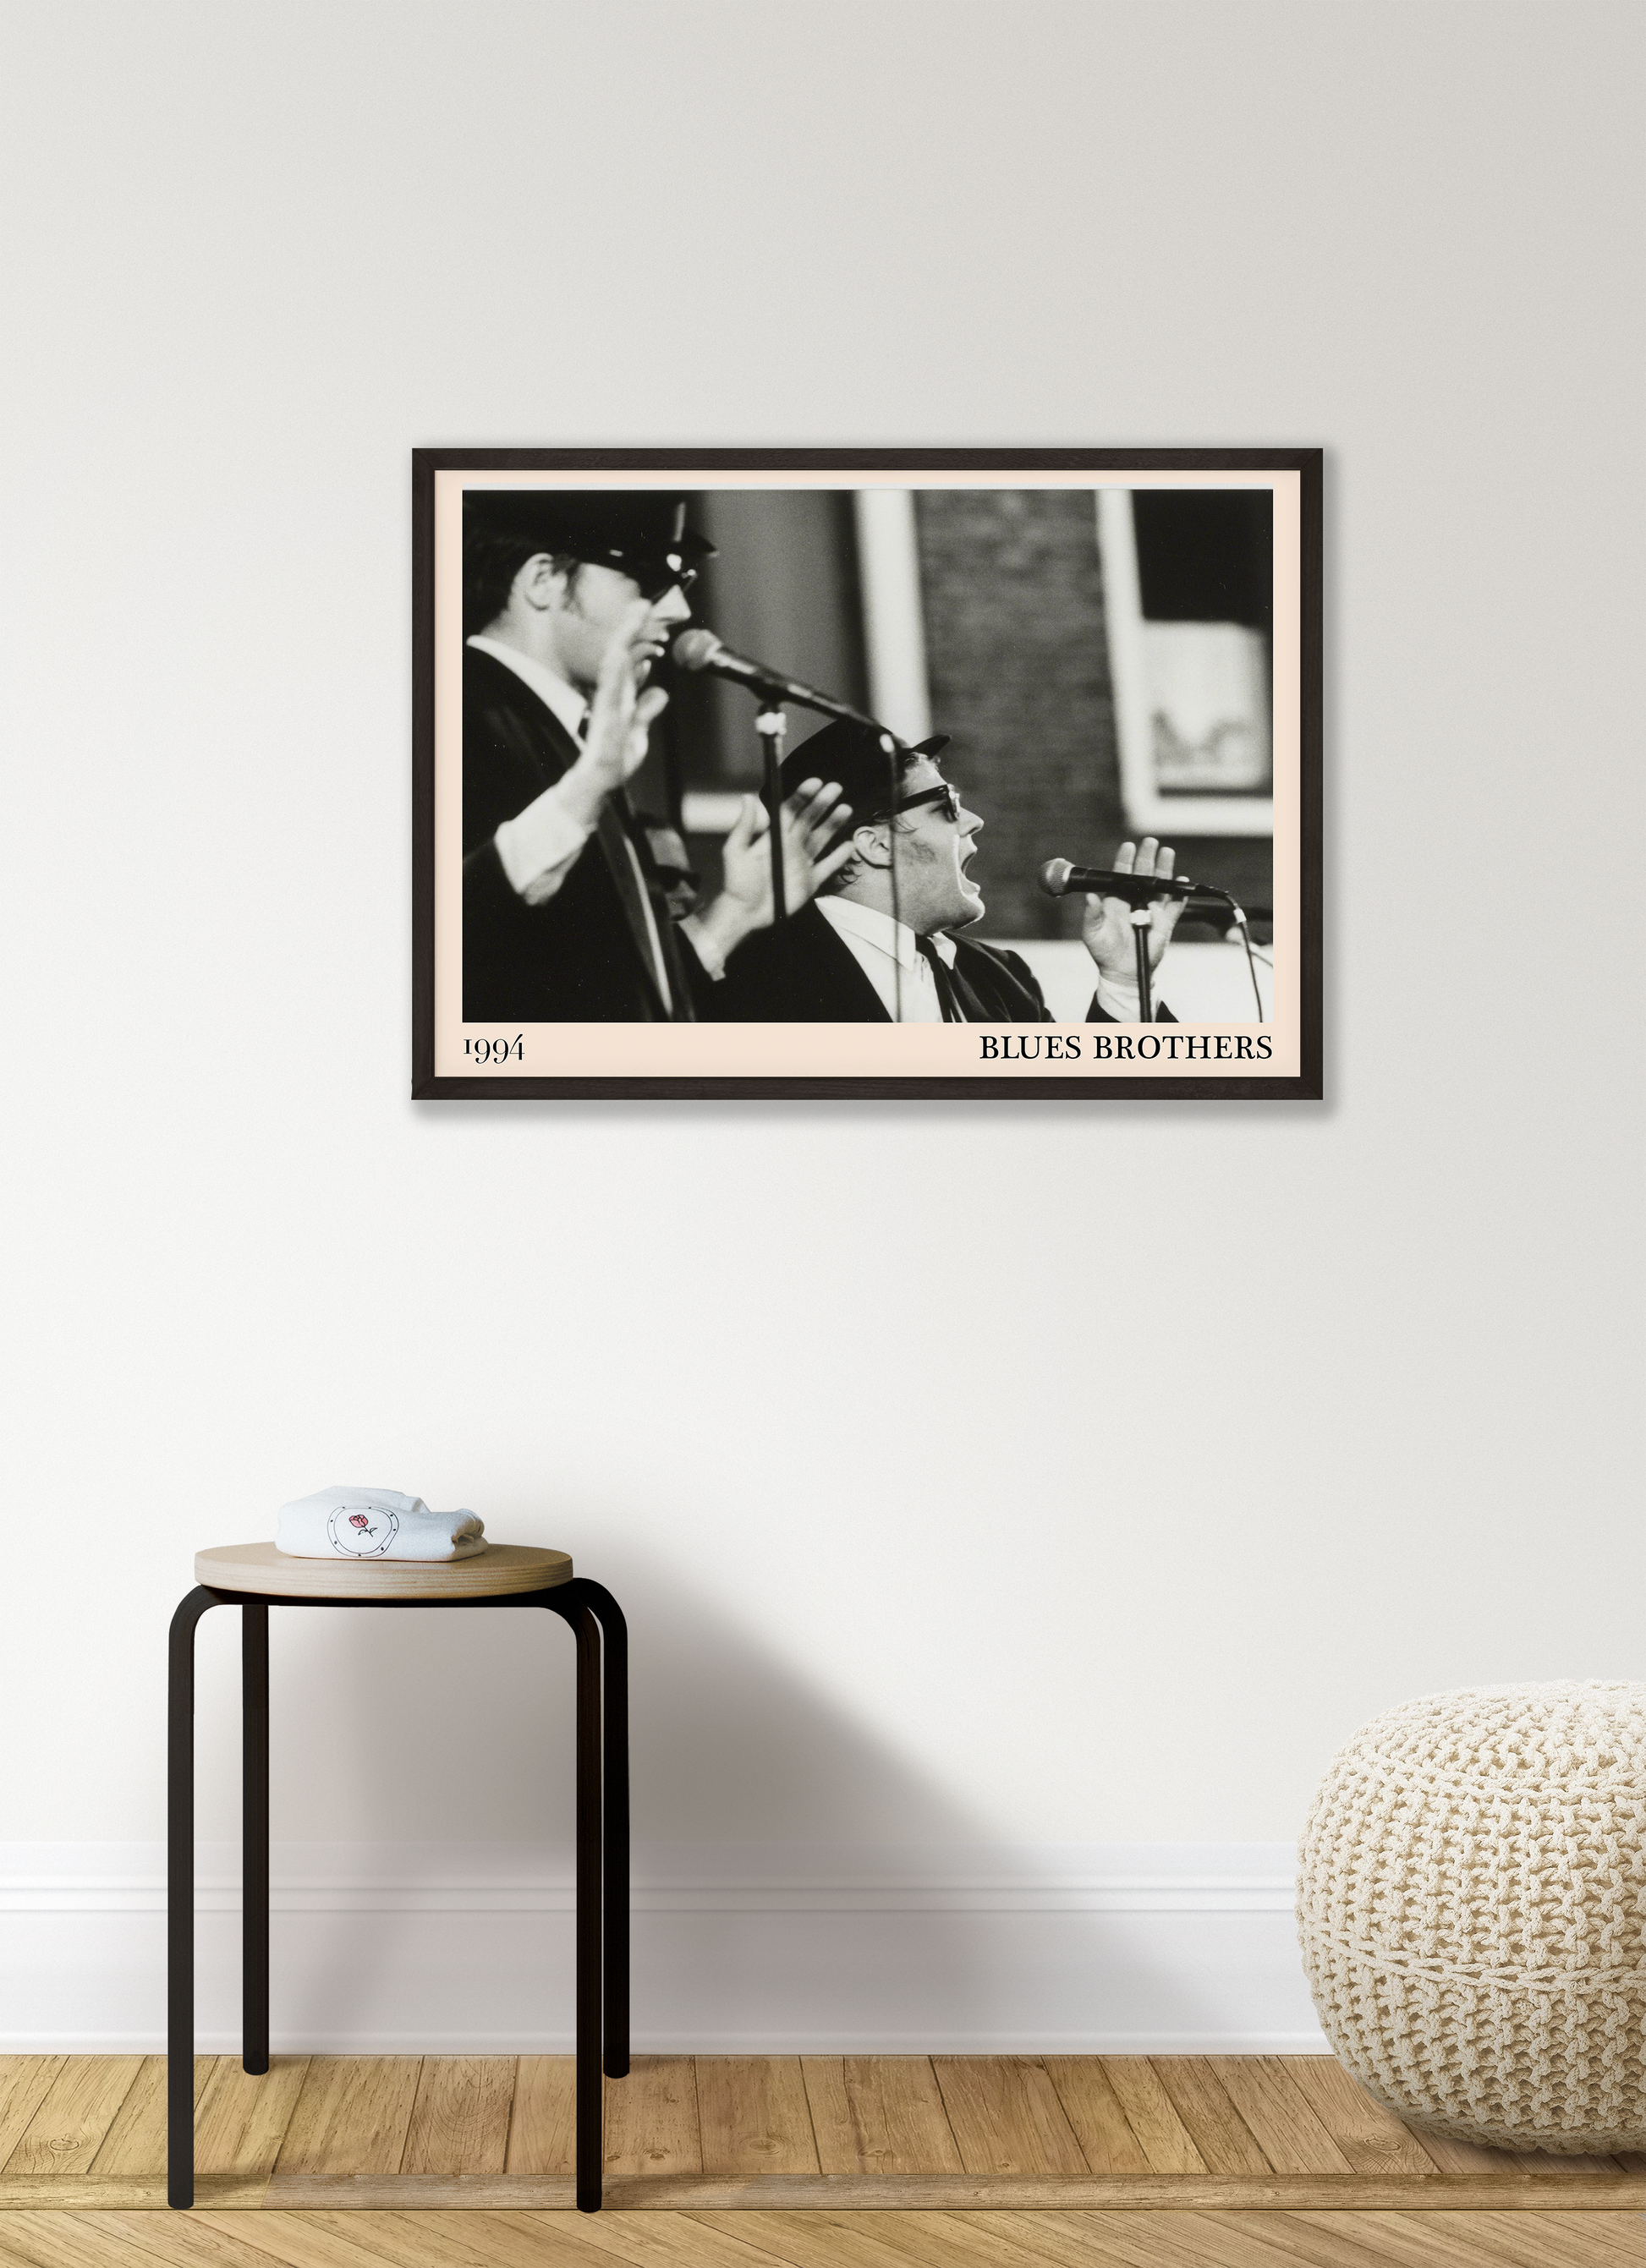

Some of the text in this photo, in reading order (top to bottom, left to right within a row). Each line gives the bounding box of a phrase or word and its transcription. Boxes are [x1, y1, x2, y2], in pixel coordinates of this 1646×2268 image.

[463, 1033, 524, 1065] 1994
[979, 1035, 1273, 1060] BLUES BROTHERS
